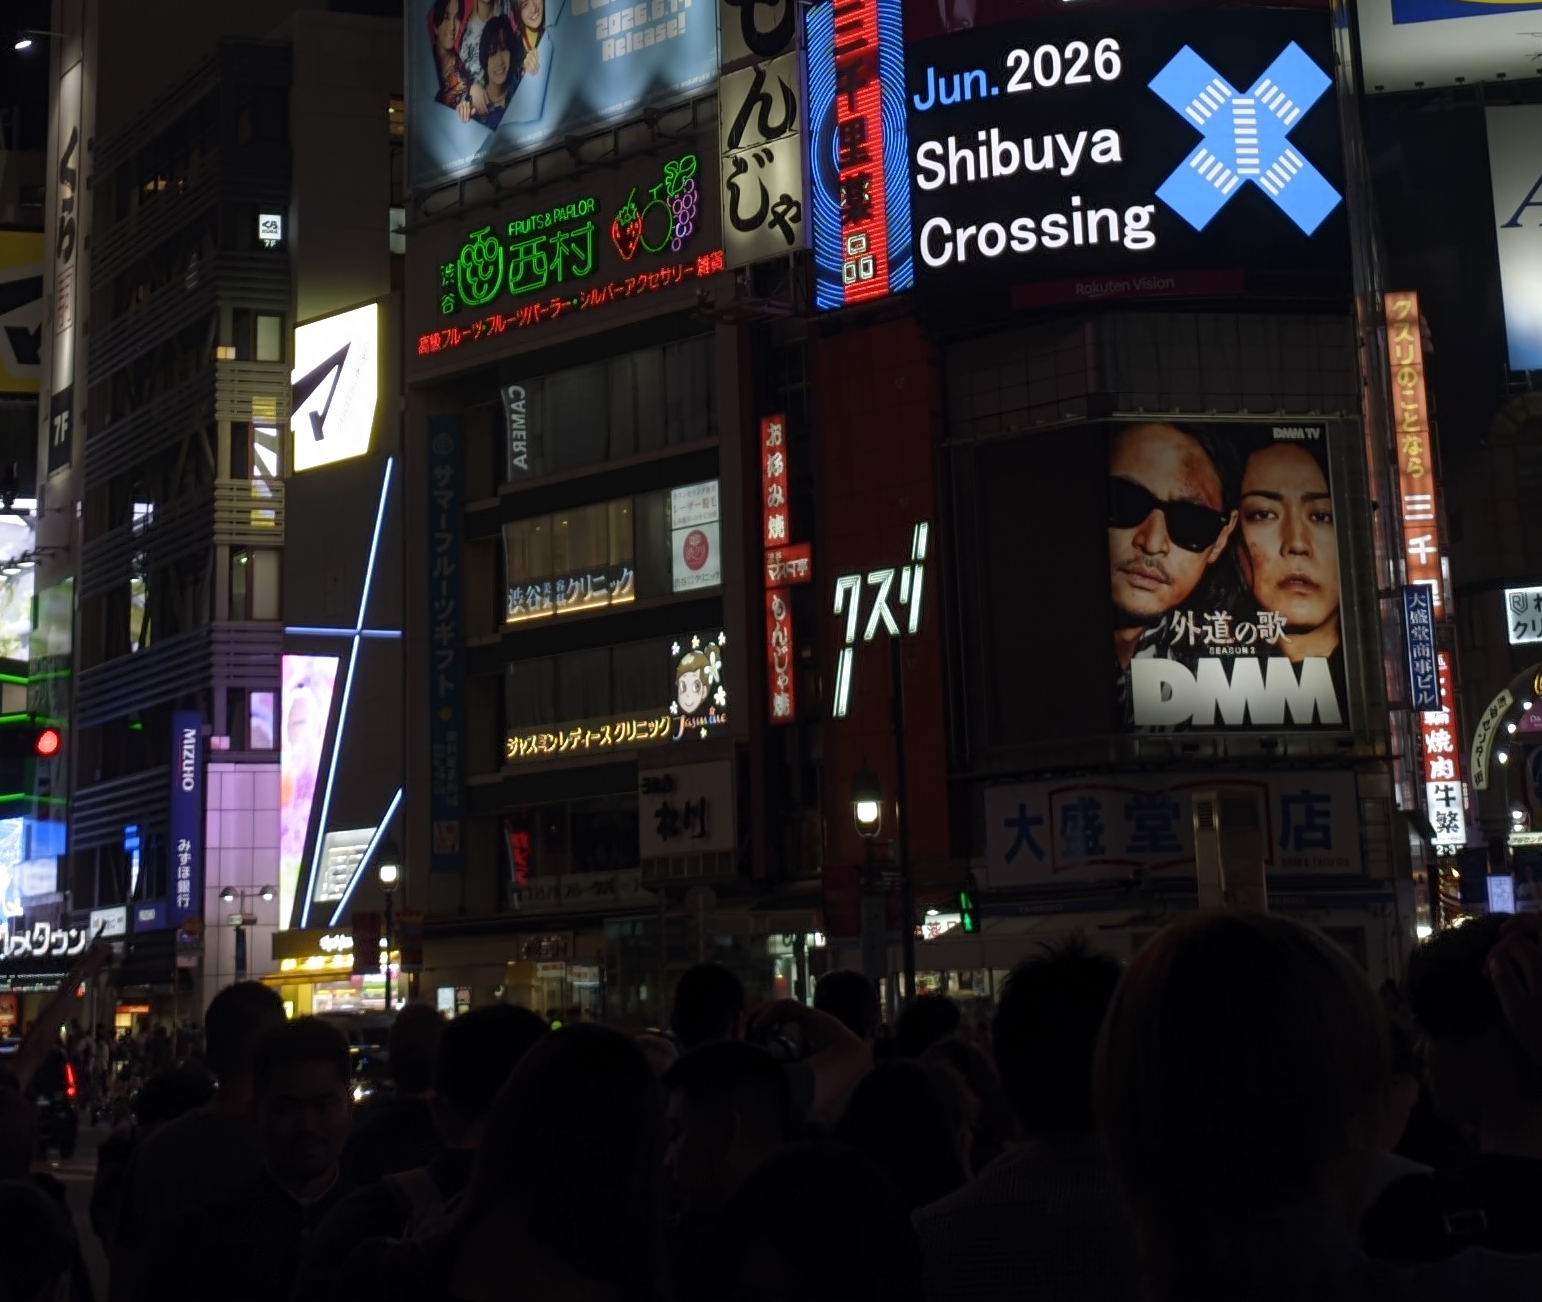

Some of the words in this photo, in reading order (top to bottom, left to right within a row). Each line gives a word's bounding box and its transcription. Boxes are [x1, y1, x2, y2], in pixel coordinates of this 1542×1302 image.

[602, 13, 687, 62] Release!
[915, 126, 1124, 192] Shibuya
[509, 221, 596, 296] 西村
[919, 195, 1158, 268] Crossing
[440, 263, 456, 316] 渋谷
[1076, 280, 1130, 296] Rakuten
[1133, 275, 1175, 291] Vision
[53, 411, 70, 448] 7F
[765, 423, 786, 540] お好み焼
[432, 464, 457, 689] サマーフルーツギフト
[832, 521, 929, 719] クスリ
[1170, 610, 1293, 647] 外道の歌
[1209, 647, 1247, 655] SEASON
[1408, 591, 1435, 706] 大盛堂商事ビル
[1131, 657, 1344, 726] DMM
[182, 727, 197, 793] MIZUHO
[1003, 789, 1333, 865] 大盛堂店
[1433, 784, 1459, 834] 牛繁
[176, 838, 192, 909] みずほ銀行
